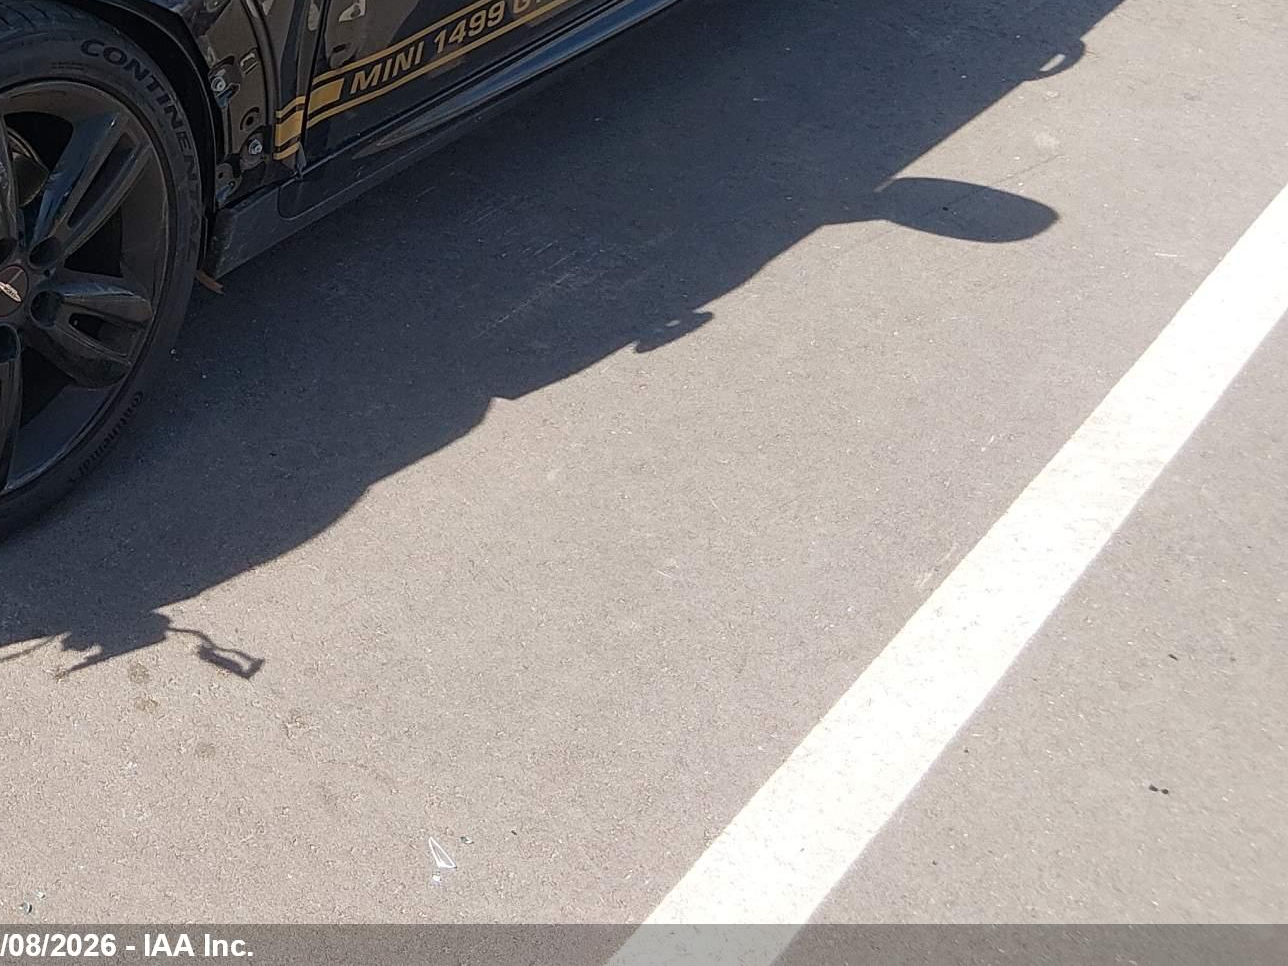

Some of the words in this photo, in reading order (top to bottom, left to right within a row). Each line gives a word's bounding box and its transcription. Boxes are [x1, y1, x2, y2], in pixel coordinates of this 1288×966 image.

[350, 40, 425, 94] MINI
[434, 0, 506, 54] 1499
[80, 38, 200, 262] CONTINENTAL
